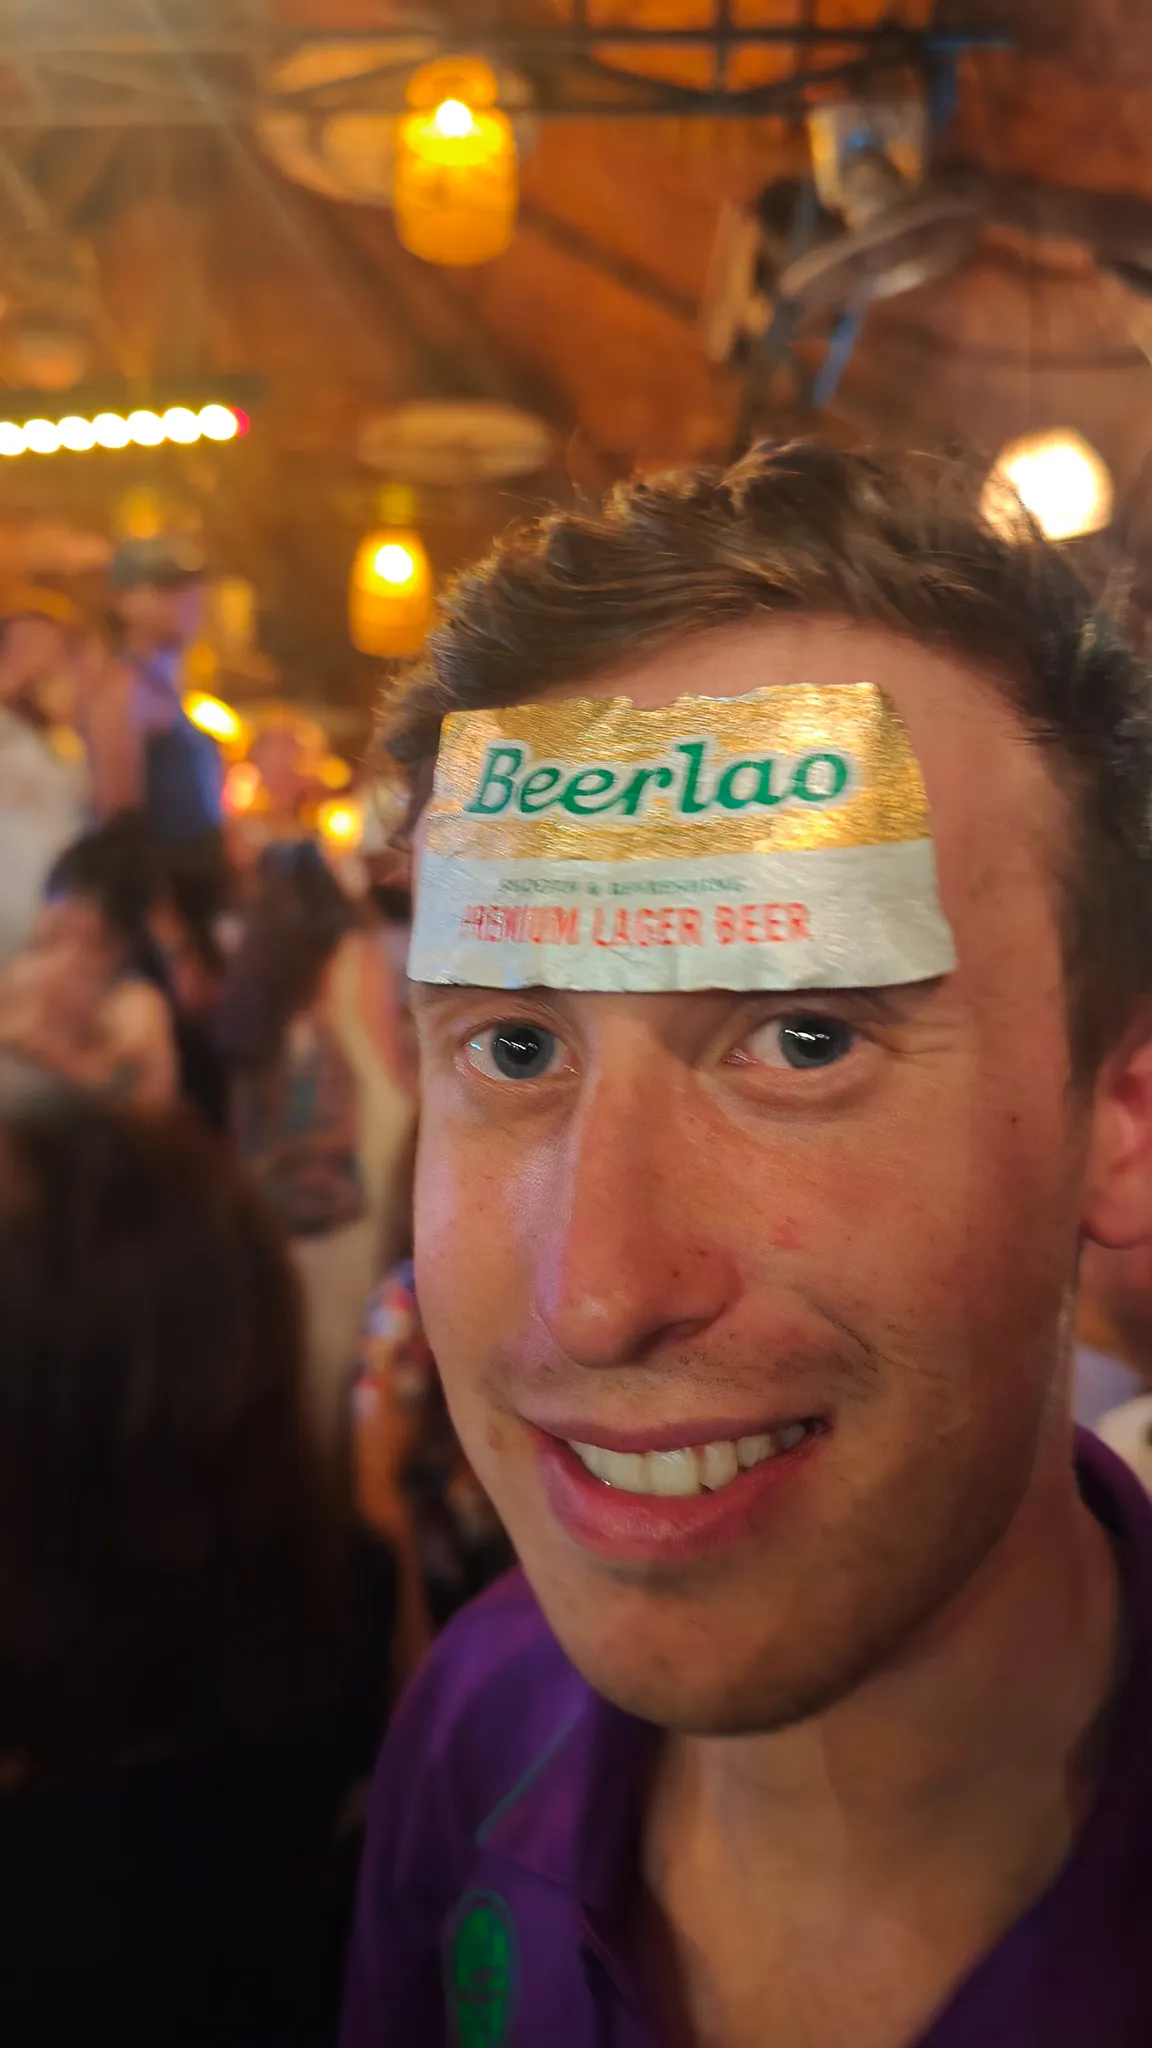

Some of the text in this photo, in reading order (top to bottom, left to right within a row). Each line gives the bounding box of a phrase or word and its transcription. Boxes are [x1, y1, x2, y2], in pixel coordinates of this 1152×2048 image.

[466, 739, 850, 816] Beerlao
[592, 906, 703, 947] LAGER
[715, 902, 810, 944] BEER
